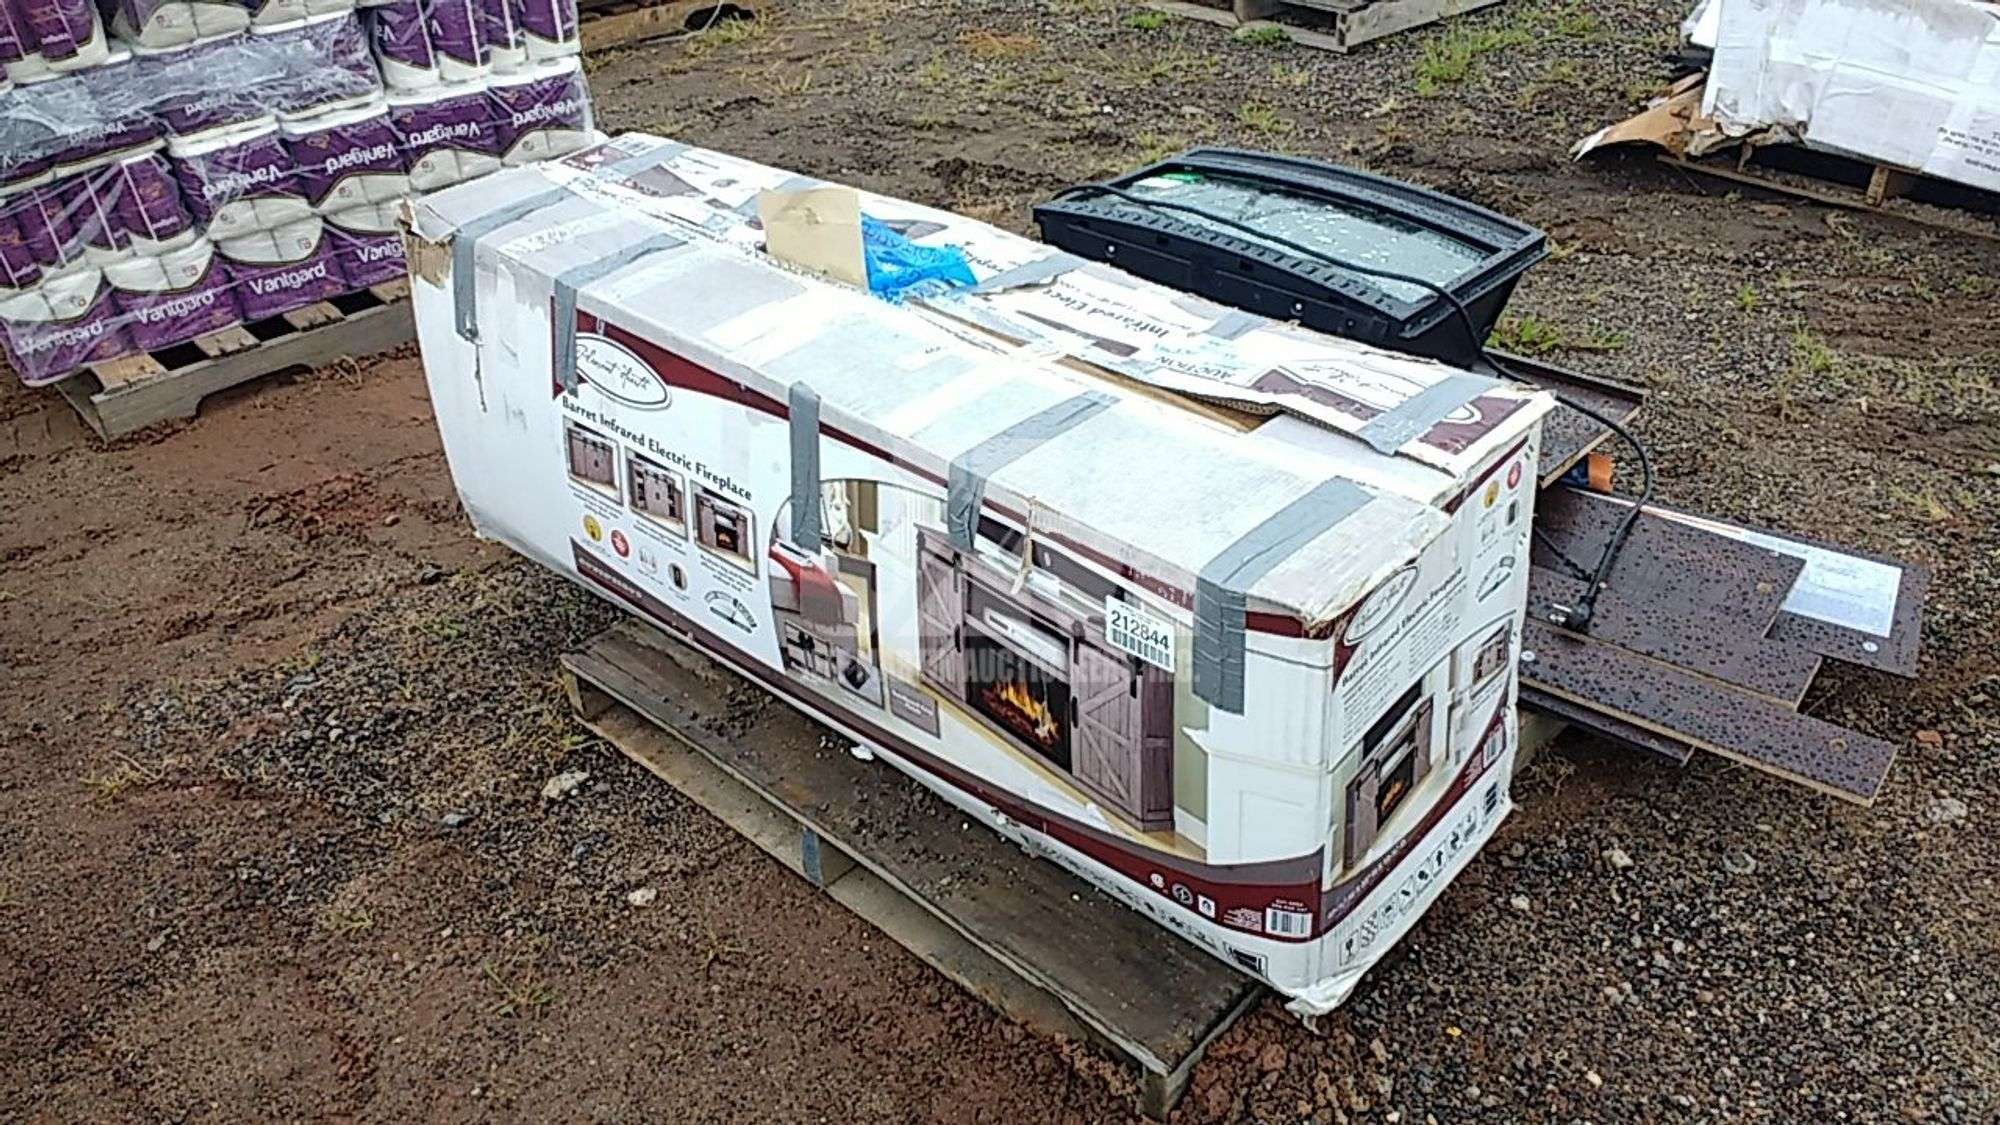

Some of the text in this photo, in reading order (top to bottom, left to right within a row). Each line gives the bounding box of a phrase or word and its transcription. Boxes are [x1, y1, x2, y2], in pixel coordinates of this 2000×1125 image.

[512, 98, 576, 127] Vantgard
[409, 121, 481, 148] Vantgard
[325, 142, 397, 175] Vantgard
[356, 240, 406, 264] Vantg
[250, 260, 326, 295] Vantgard
[135, 289, 215, 324] Vantgard
[562, 395, 753, 501] Barret Infrared Electric Fireplace
[1110, 609, 1170, 651] 212844
